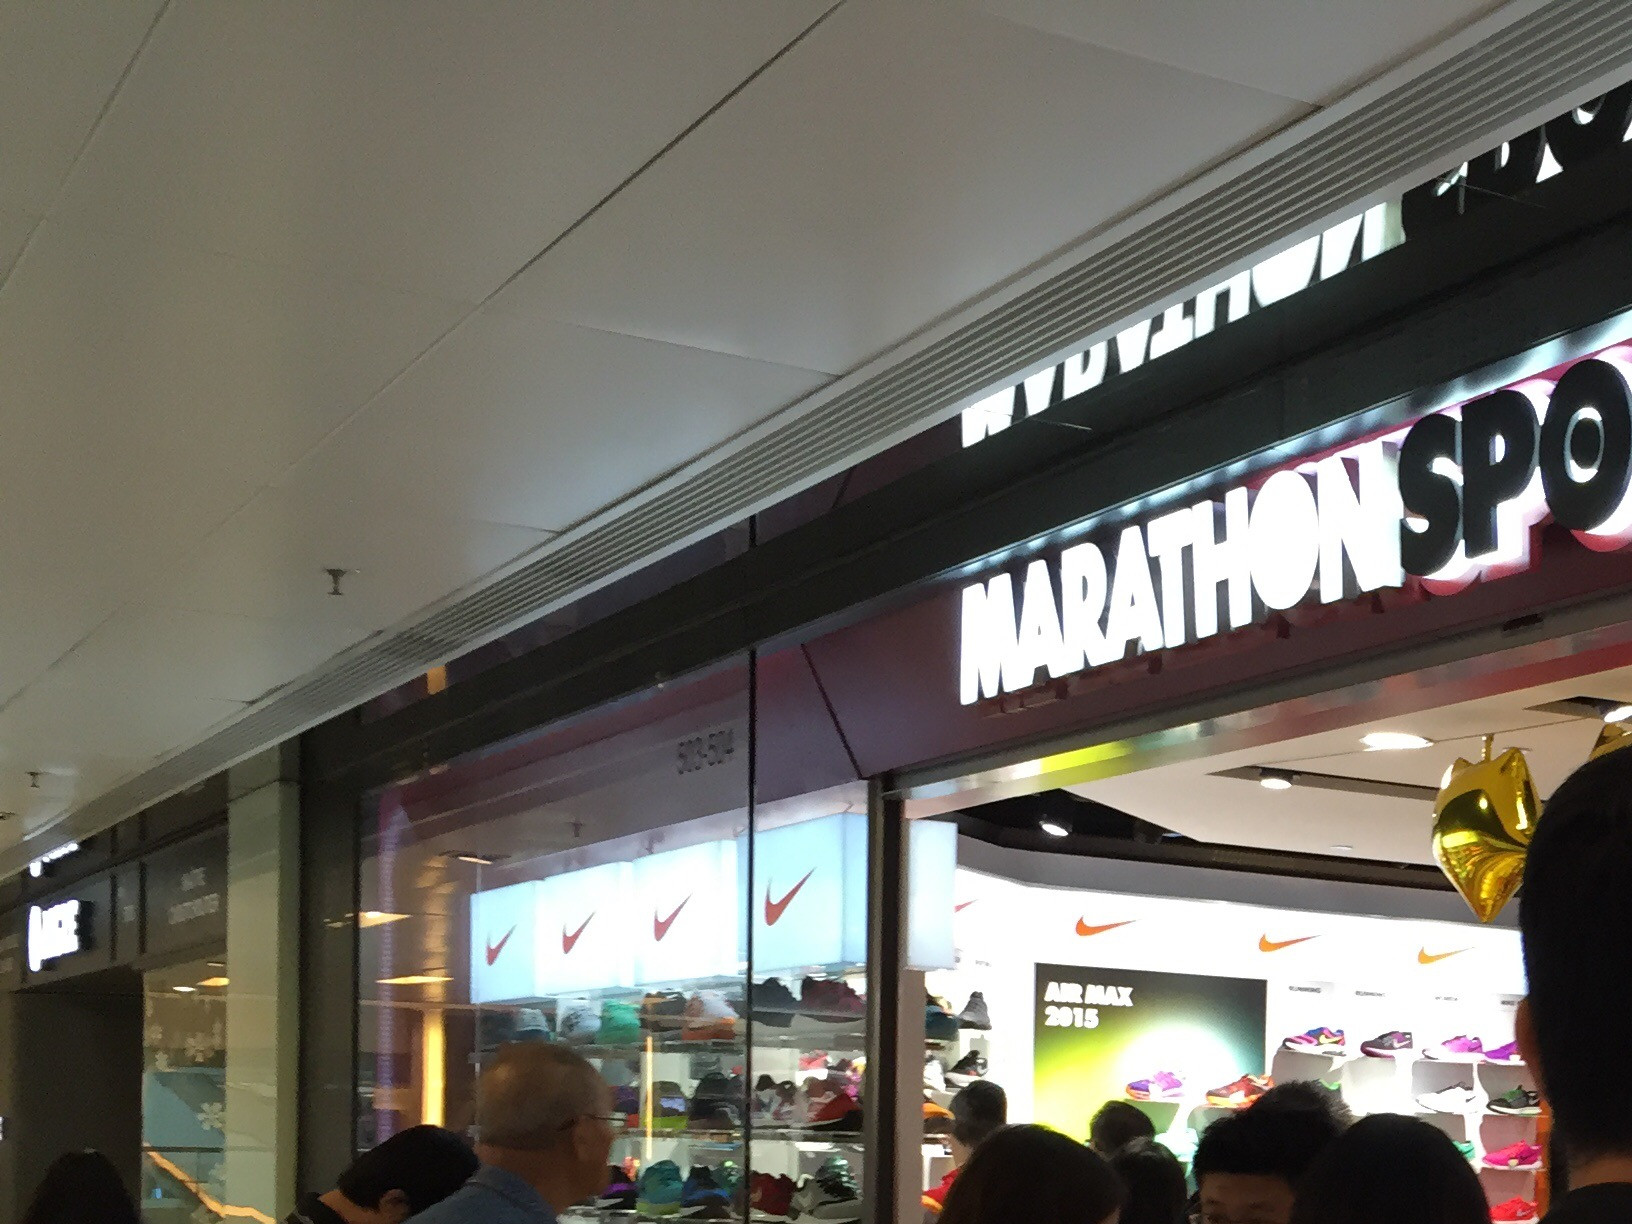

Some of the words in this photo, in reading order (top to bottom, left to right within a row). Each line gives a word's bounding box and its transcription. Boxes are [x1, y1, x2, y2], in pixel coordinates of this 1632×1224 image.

[959, 440, 1402, 706] MARATHON
[1043, 981, 1084, 1004] AIR
[1084, 983, 1134, 1007] MAX
[1044, 1005, 1100, 1029] 2015
